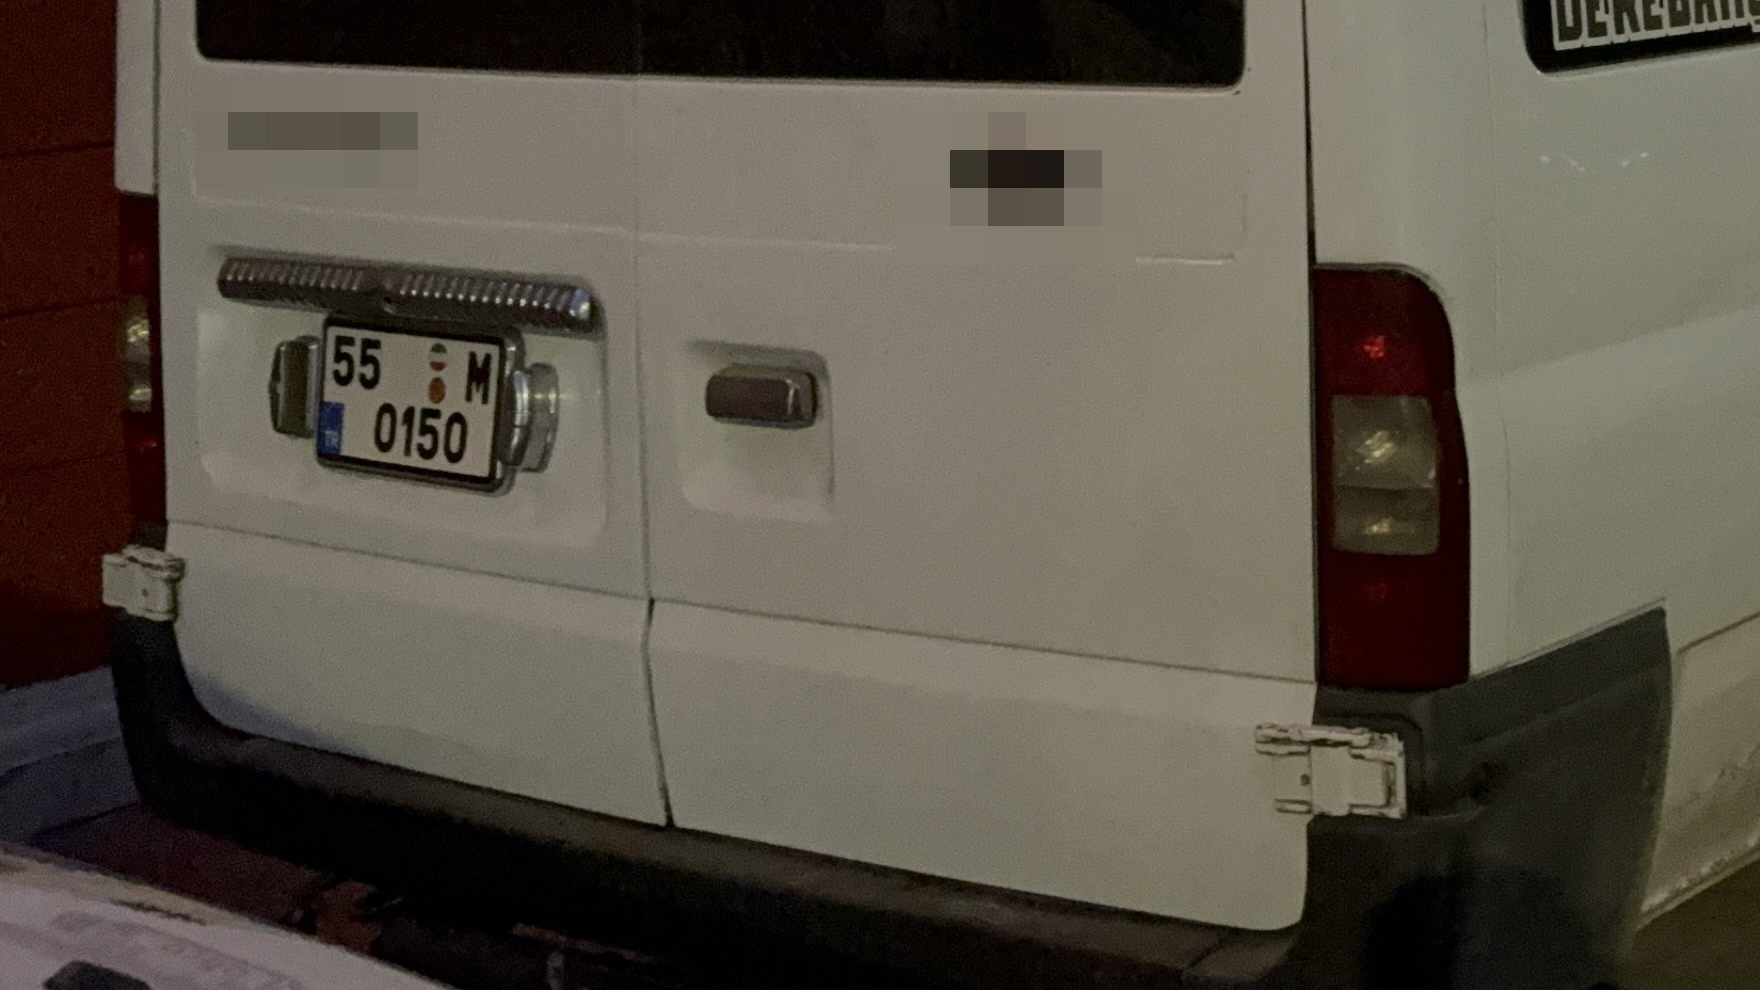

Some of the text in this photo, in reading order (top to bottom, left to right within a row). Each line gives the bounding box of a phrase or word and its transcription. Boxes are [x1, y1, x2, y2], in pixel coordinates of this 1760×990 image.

[333, 335, 492, 405] 55 M
[374, 402, 468, 464] 0150
